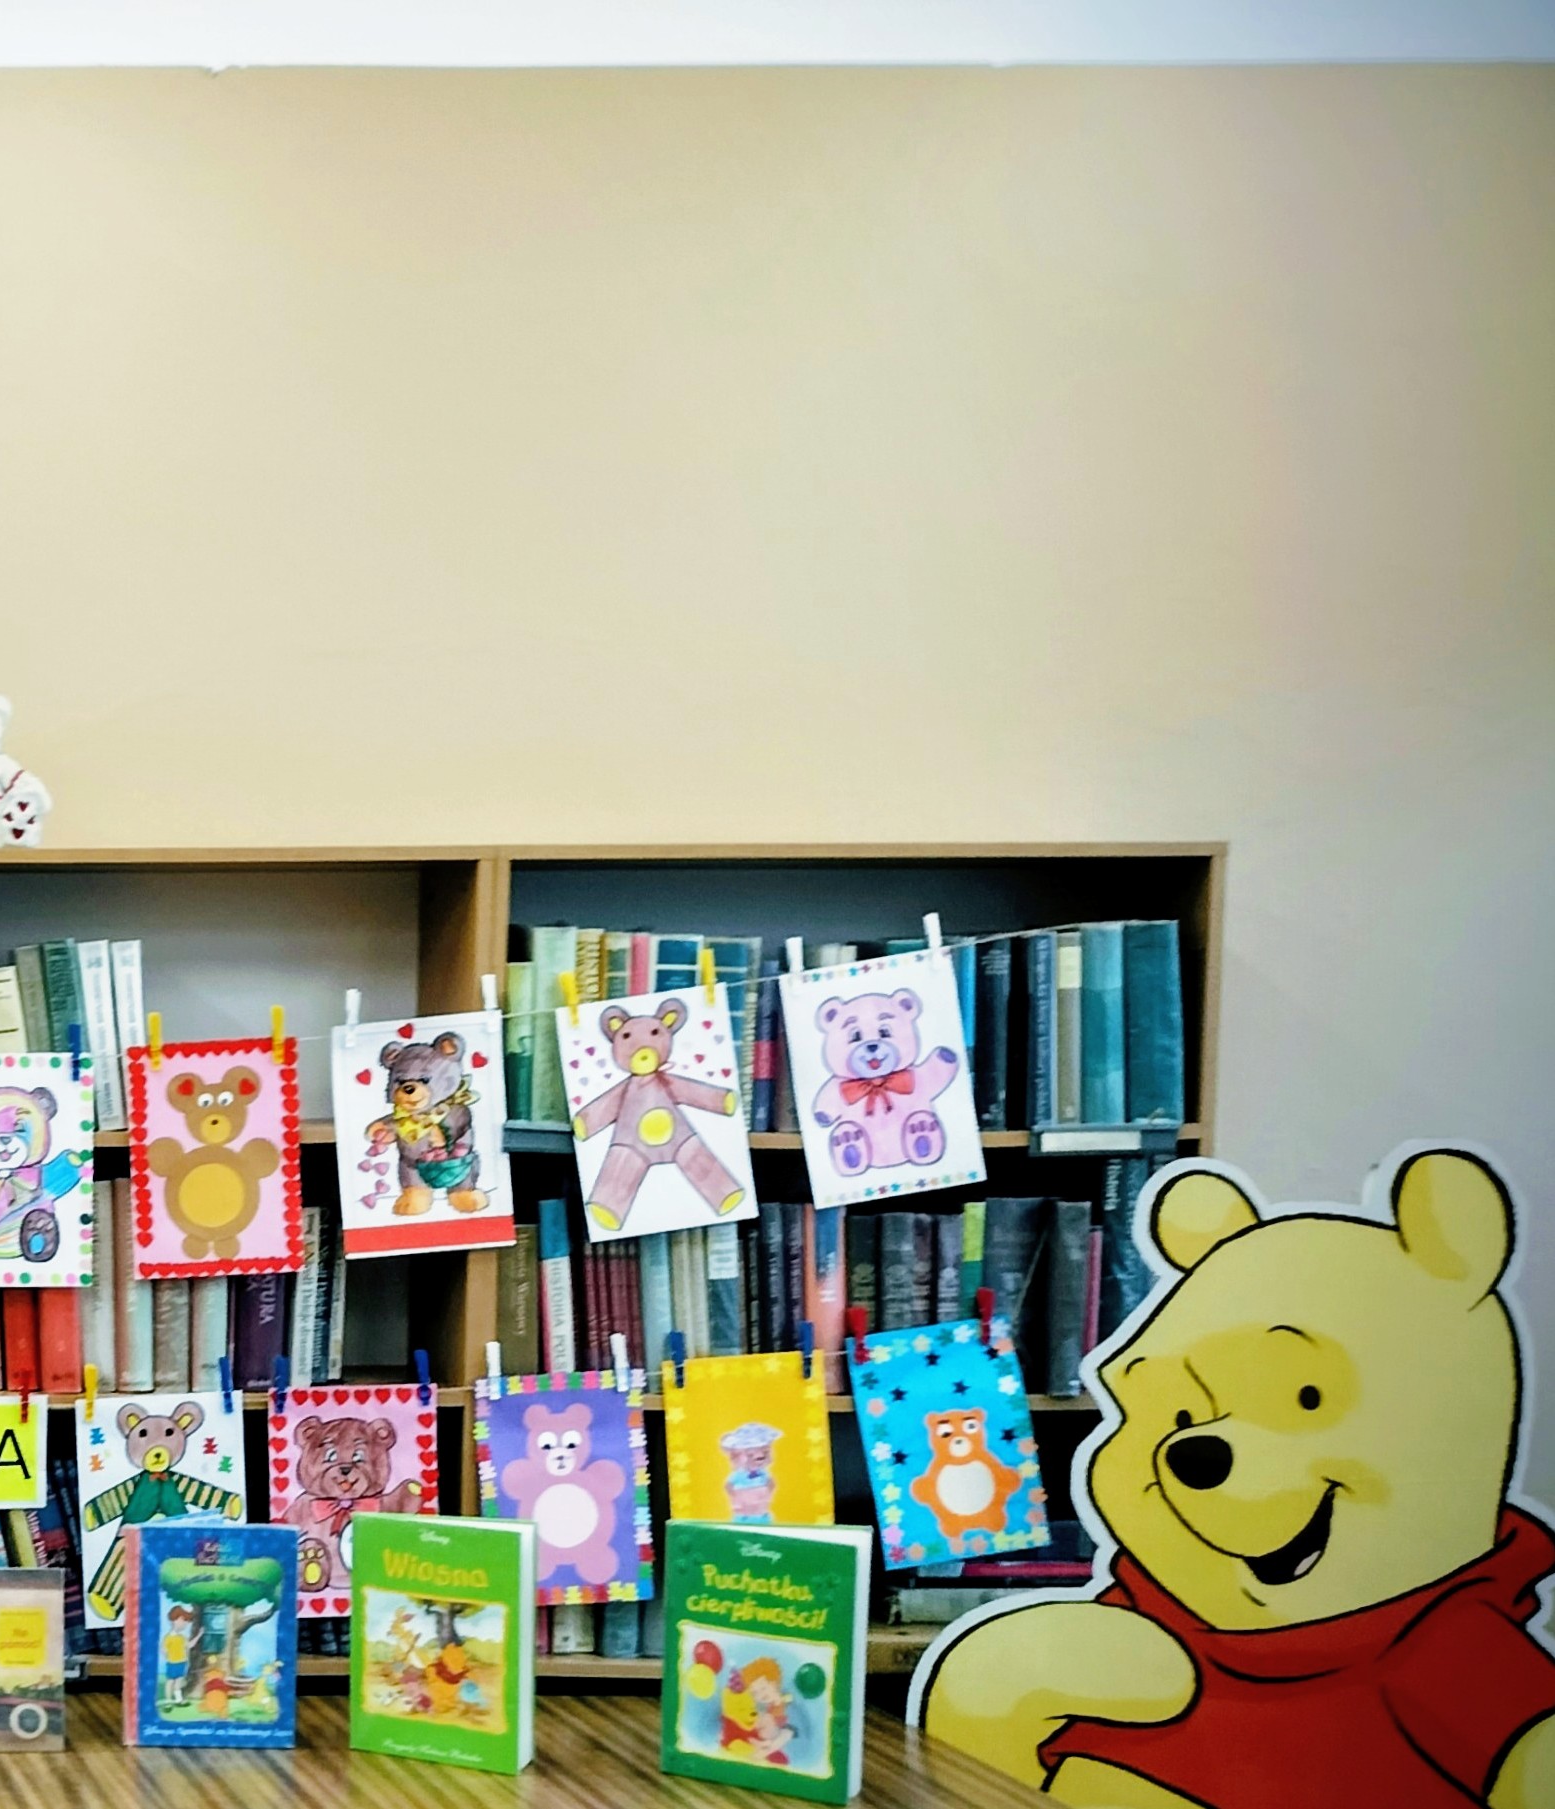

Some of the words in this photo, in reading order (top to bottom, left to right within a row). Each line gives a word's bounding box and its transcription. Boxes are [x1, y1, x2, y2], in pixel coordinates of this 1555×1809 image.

[551, 1260, 568, 1327] HISTORIA
[382, 1547, 490, 1589] Wiosna
[686, 1593, 829, 1631] cierpliwości!
